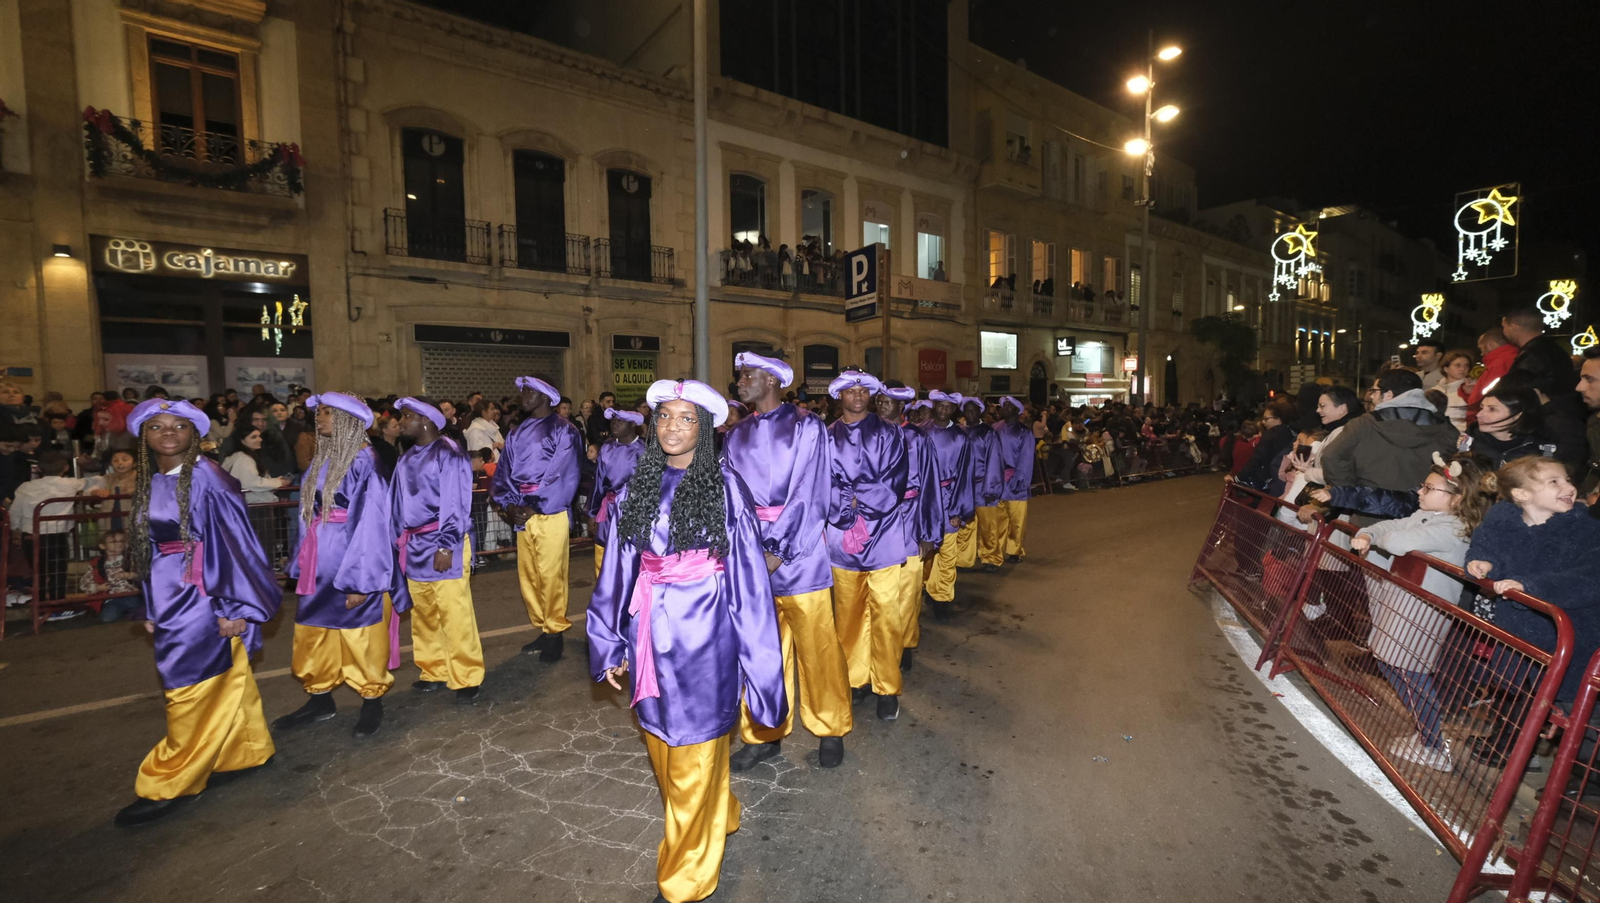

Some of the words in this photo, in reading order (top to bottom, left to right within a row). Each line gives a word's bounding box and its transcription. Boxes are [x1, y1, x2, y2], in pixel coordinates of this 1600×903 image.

[165, 248, 295, 277] cajamar
[851, 253, 869, 296] P
[614, 359, 625, 369] SE
[627, 359, 653, 369] VENDE
[615, 373, 620, 384] O
[623, 374, 654, 384] ALQUILA
